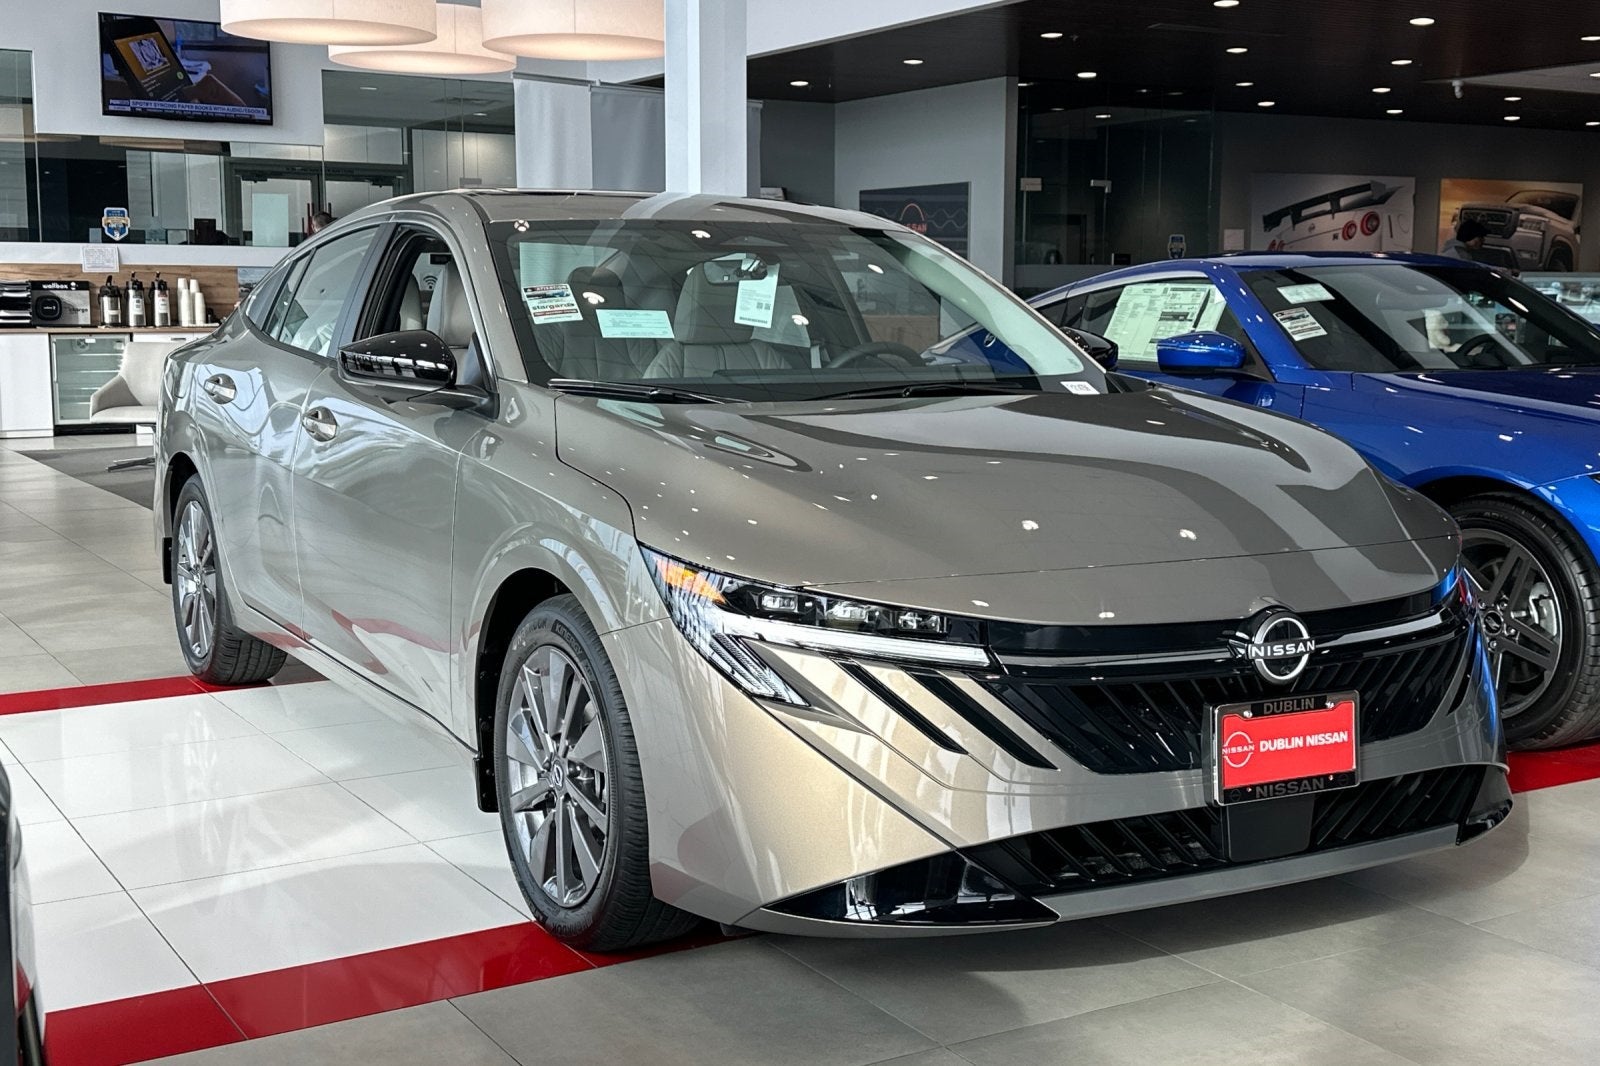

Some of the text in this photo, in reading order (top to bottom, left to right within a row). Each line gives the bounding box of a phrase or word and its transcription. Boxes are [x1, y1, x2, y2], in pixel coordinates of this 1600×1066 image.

[555, 622, 583, 654] KINERGY
[1251, 640, 1315, 657] NISSAN
[1263, 698, 1315, 715] DUBLIN
[1222, 744, 1255, 755] NISSAN
[1259, 731, 1348, 753] DUBLIN NISSAN
[1255, 777, 1325, 799] NISSAN
